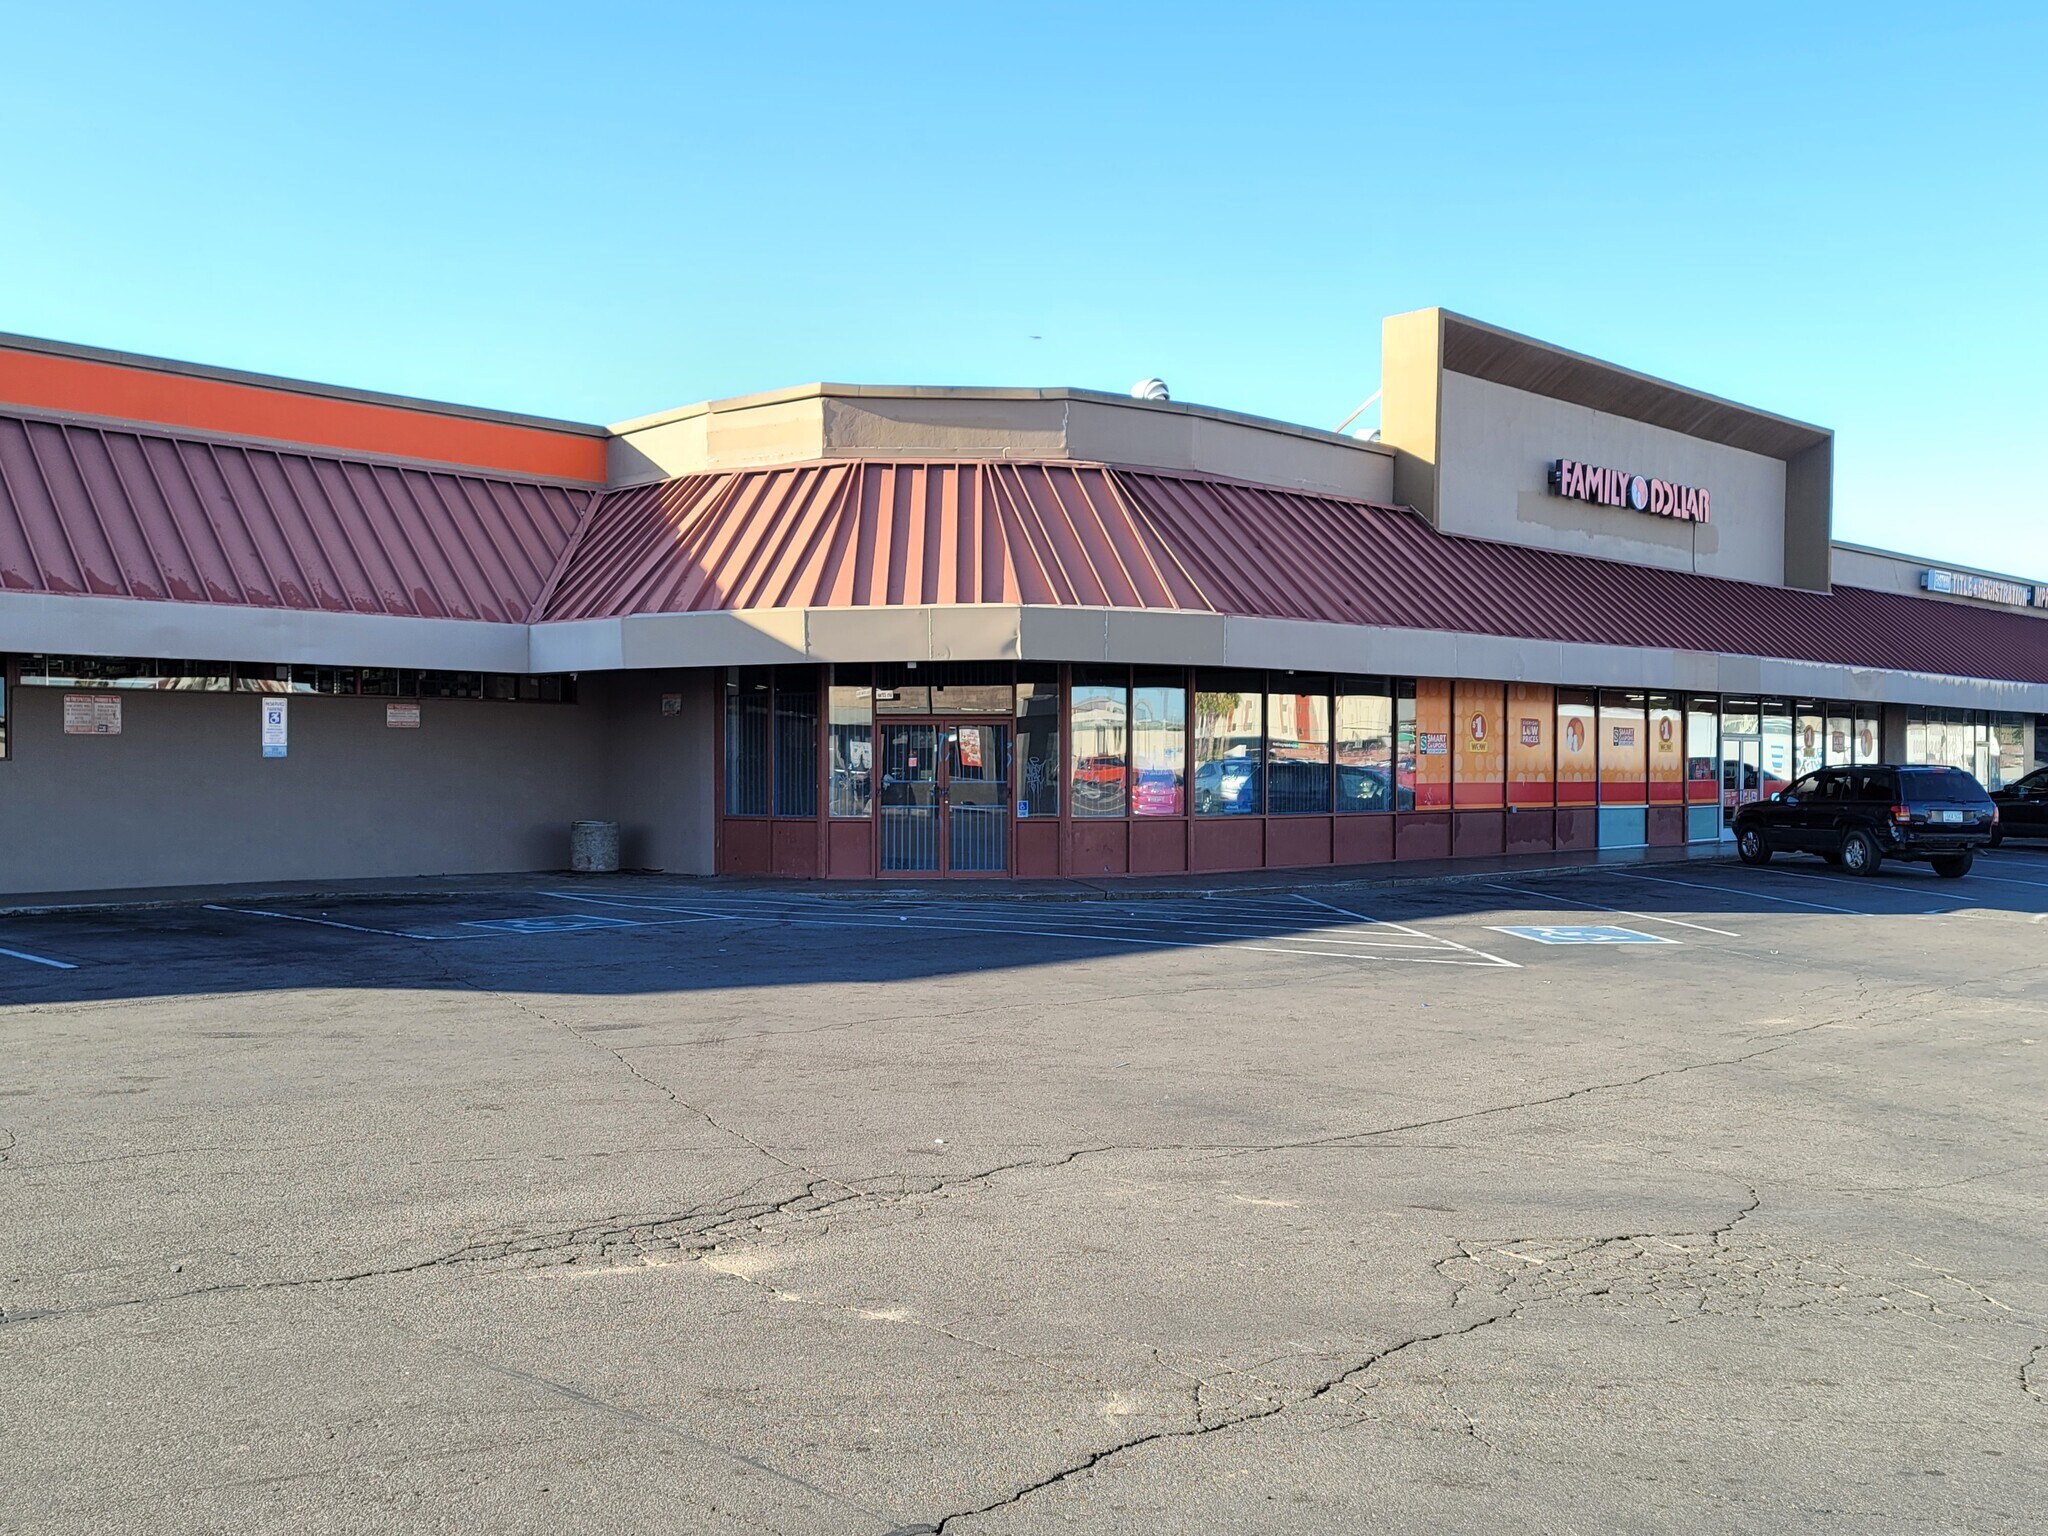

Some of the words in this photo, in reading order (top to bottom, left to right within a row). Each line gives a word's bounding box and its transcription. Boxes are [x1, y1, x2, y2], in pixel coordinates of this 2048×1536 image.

[1561, 459, 1630, 507] FAMILY
[1651, 478, 1710, 523] DOLLAR
[1952, 573, 1973, 596] TITLE
[1978, 578, 2028, 607] REGISTRATION
[1472, 716, 1483, 738] $1
[1522, 725, 1539, 735] LOW
[1427, 733, 1447, 743] SMART
[1522, 735, 1539, 743] PRICES
